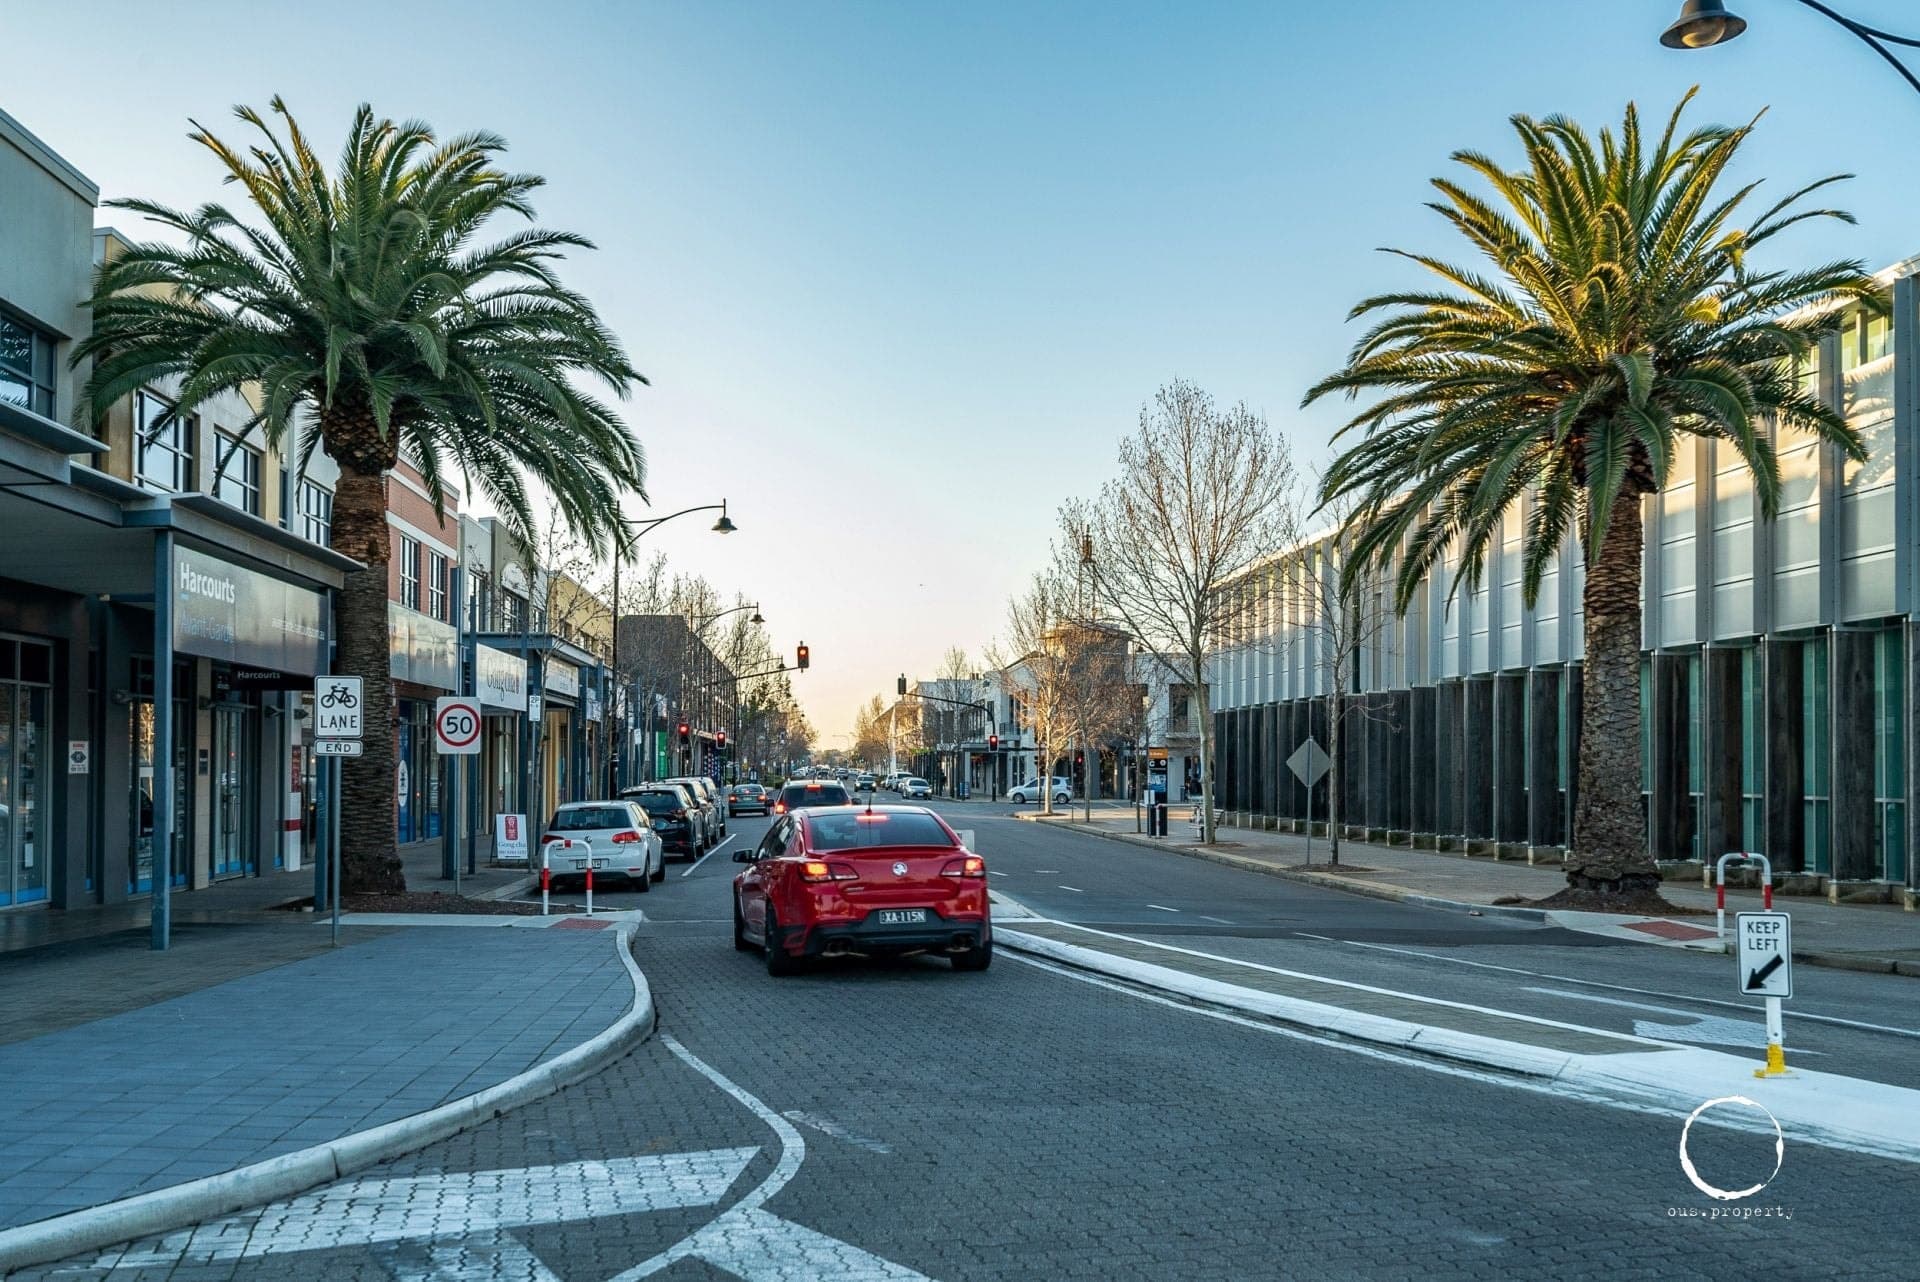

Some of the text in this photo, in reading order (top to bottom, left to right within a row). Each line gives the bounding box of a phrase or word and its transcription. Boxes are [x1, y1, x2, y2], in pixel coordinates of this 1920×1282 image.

[180, 562, 235, 604] Harcourts
[237, 671, 280, 679] Harcourts
[320, 715, 358, 728] LANE
[446, 716, 473, 735] 50
[326, 743, 352, 753] END
[1747, 921, 1781, 934] KEEP
[1748, 938, 1779, 951] LEFT
